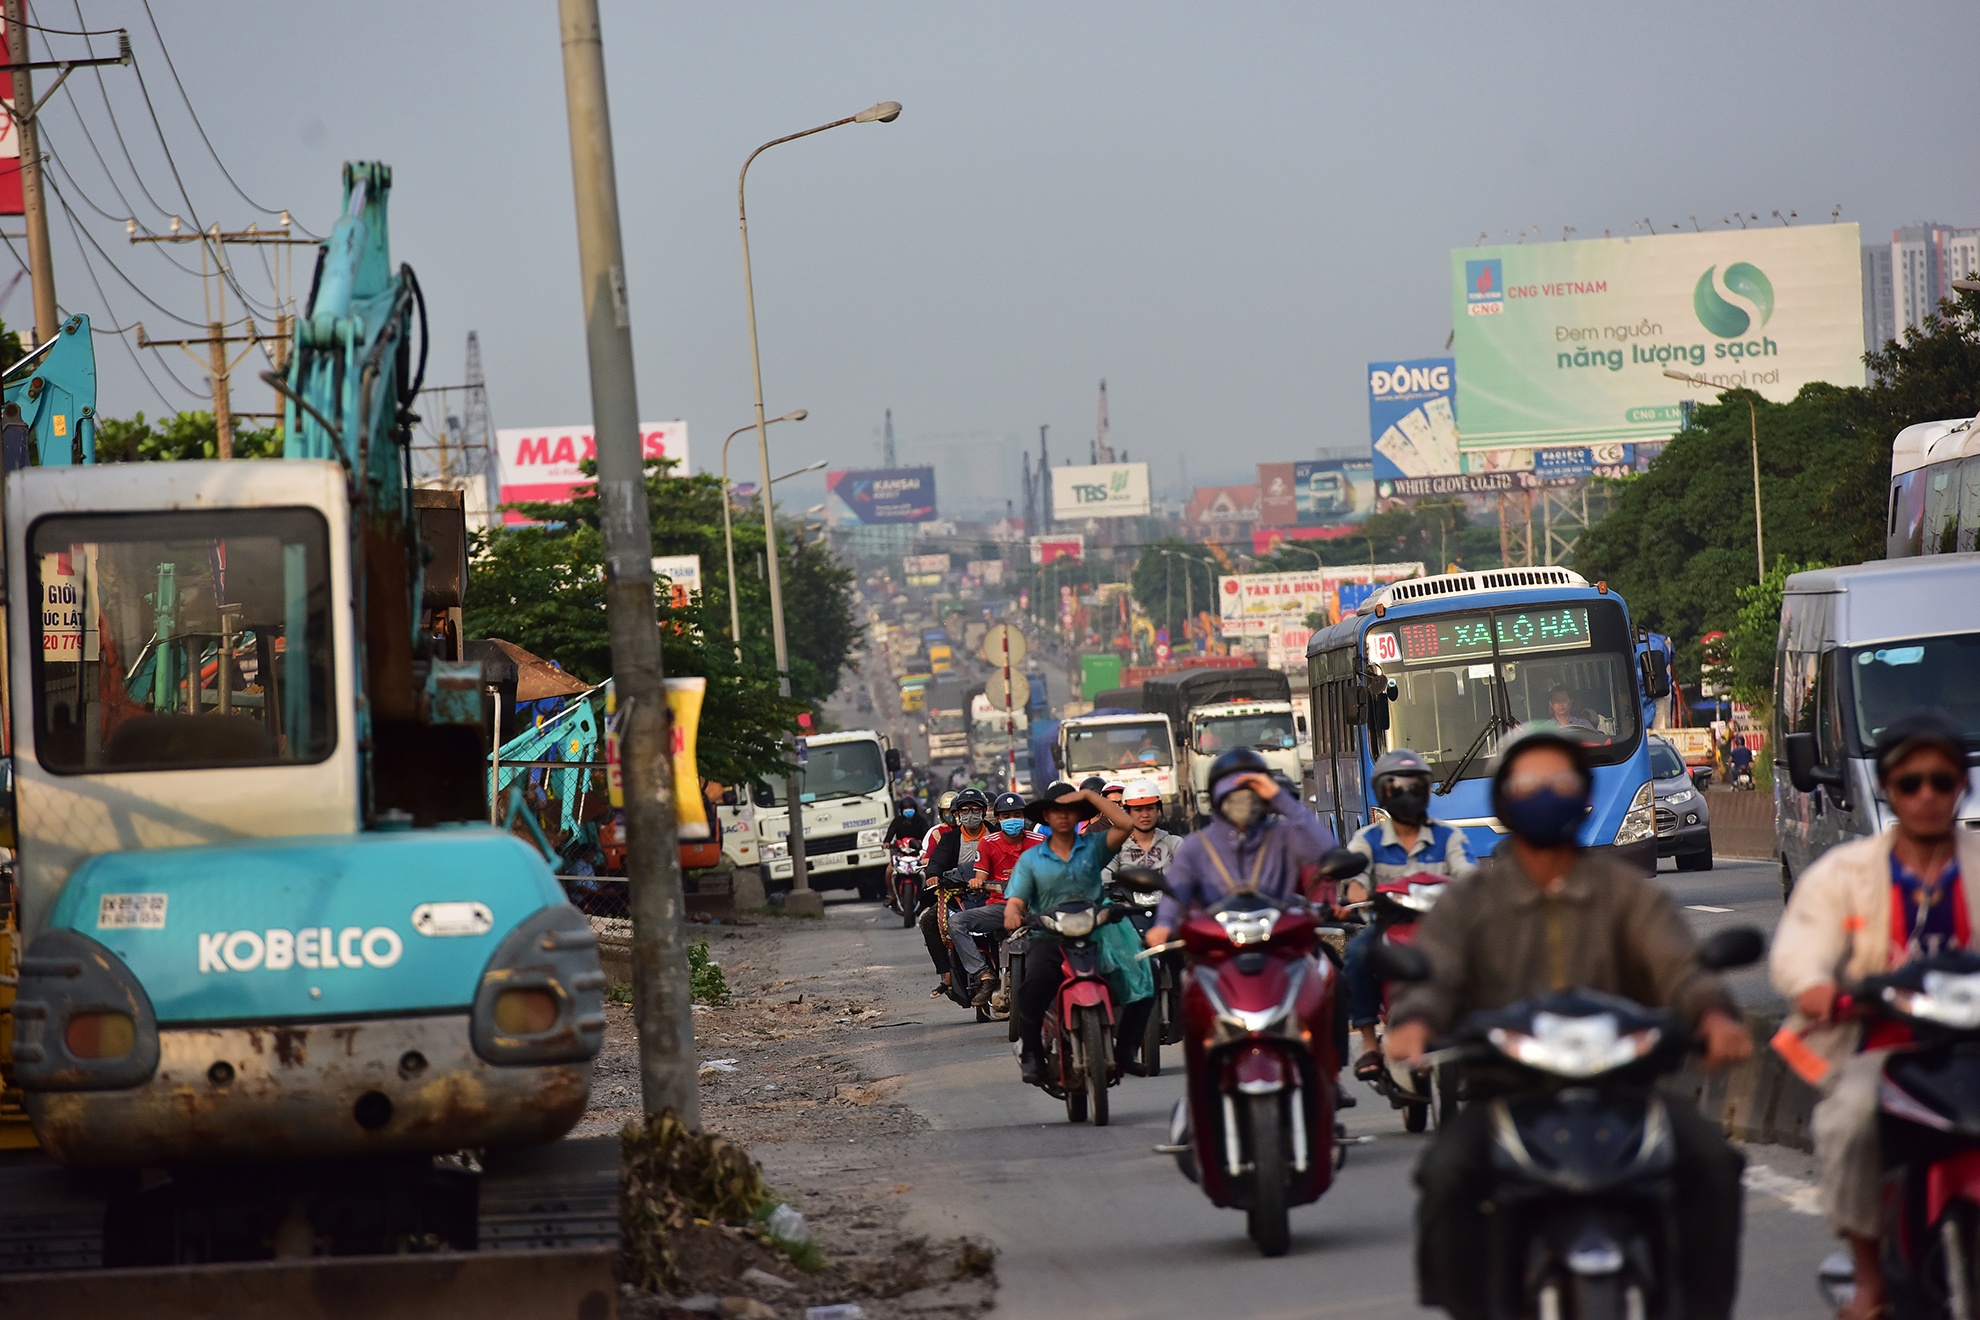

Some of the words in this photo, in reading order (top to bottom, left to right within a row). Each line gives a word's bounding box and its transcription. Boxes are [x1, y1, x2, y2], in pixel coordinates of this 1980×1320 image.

[1507, 285, 1538, 299] CNG
[1541, 280, 1607, 297] VIETNAM
[1471, 302, 1500, 315] CNG
[1555, 323, 1600, 342] Đem
[1603, 318, 1663, 344] nguồn
[1557, 344, 1623, 372] năng
[1632, 342, 1706, 367] lượng
[1715, 336, 1778, 363] sạch
[1371, 365, 1450, 395] ĐÔNG
[1752, 367, 1780, 385] nơi
[1632, 410, 1656, 420] CNG
[1665, 409, 1680, 419] LN
[1071, 484, 1108, 503] TBS
[1394, 478, 1432, 495] WHITE
[1433, 476, 1470, 493] GLOVE
[48, 582, 77, 605] GIỚI
[42, 609, 60, 626] ÚC
[1402, 622, 1439, 658] 150
[1454, 622, 1493, 648] XA
[198, 925, 404, 974] KOBELCO
